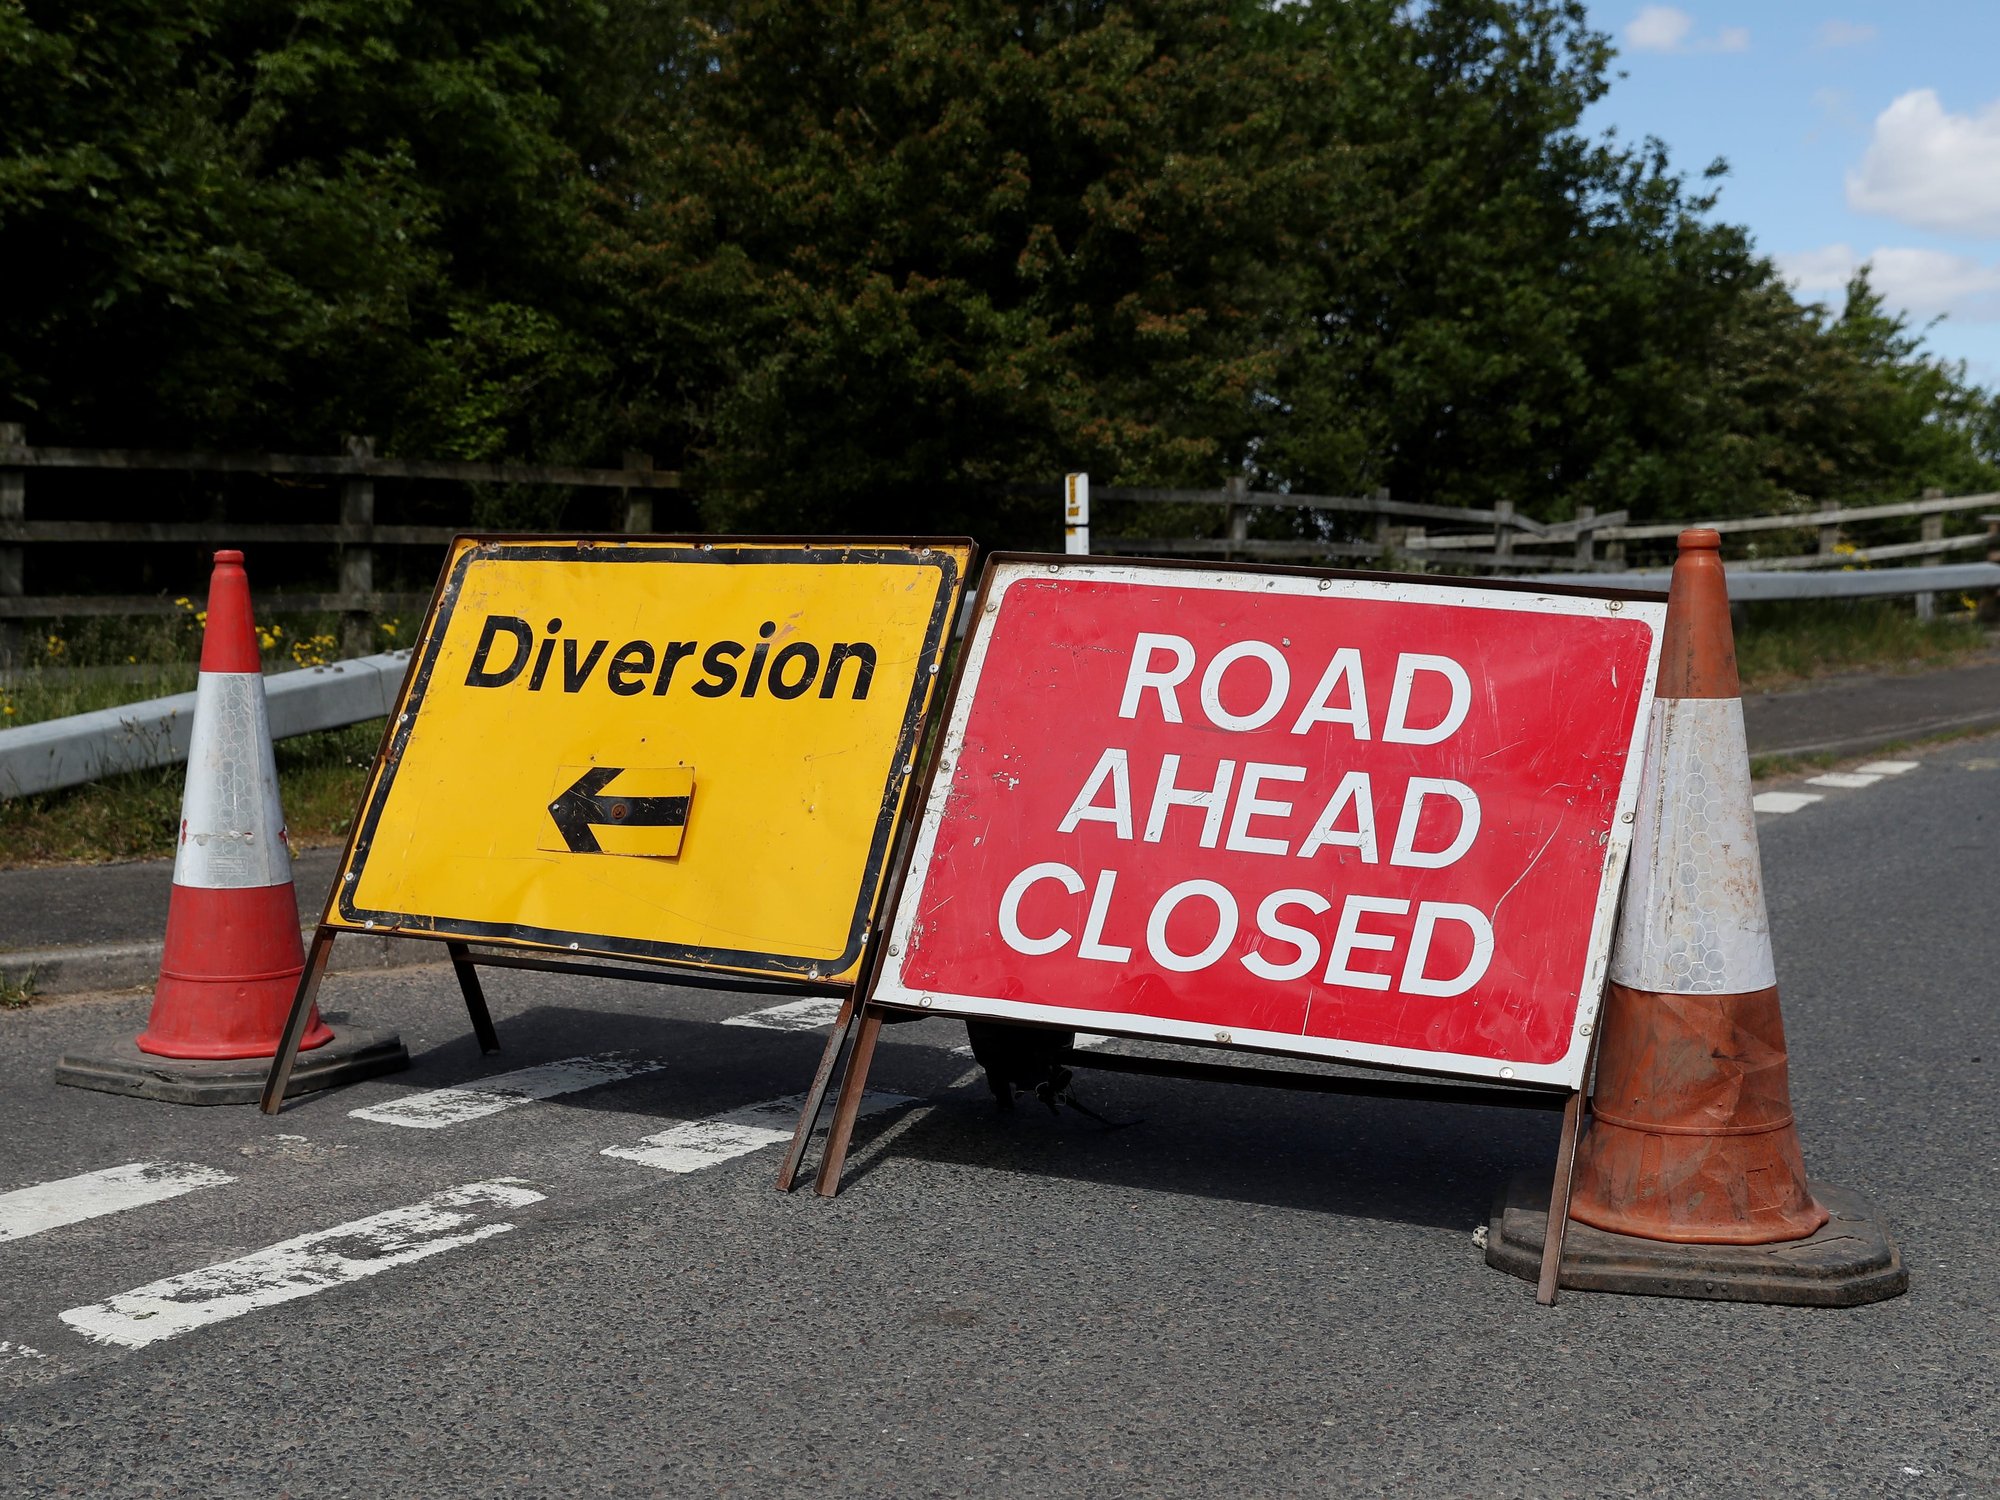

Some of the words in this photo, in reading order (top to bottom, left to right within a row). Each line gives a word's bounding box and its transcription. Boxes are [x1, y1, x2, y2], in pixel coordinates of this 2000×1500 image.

[465, 616, 876, 700] Diversion
[1119, 633, 1472, 745] ROAD
[1057, 748, 1481, 868] AHEAD
[999, 862, 1494, 997] CLOSED
